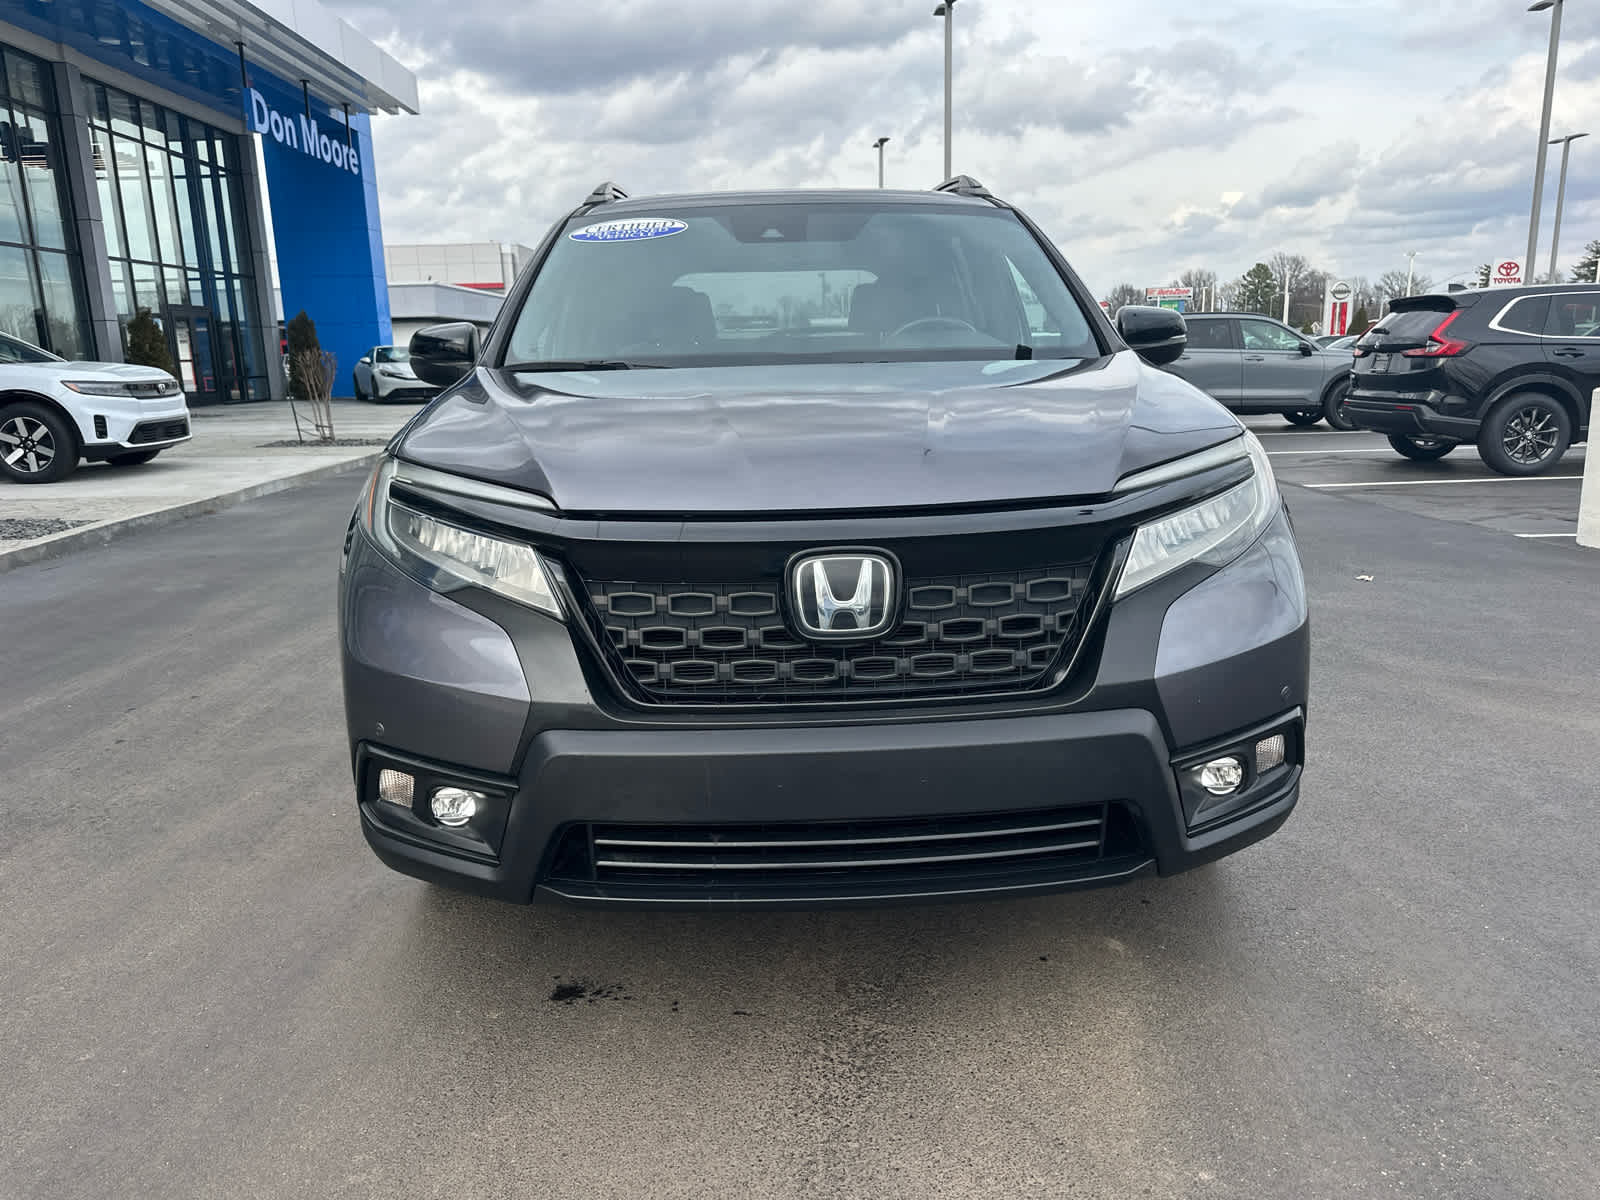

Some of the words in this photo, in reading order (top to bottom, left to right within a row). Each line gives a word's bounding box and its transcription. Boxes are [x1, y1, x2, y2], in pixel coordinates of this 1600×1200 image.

[250, 88, 298, 149] Don
[299, 113, 359, 175] Moore
[585, 221, 675, 233] CERTIFIED
